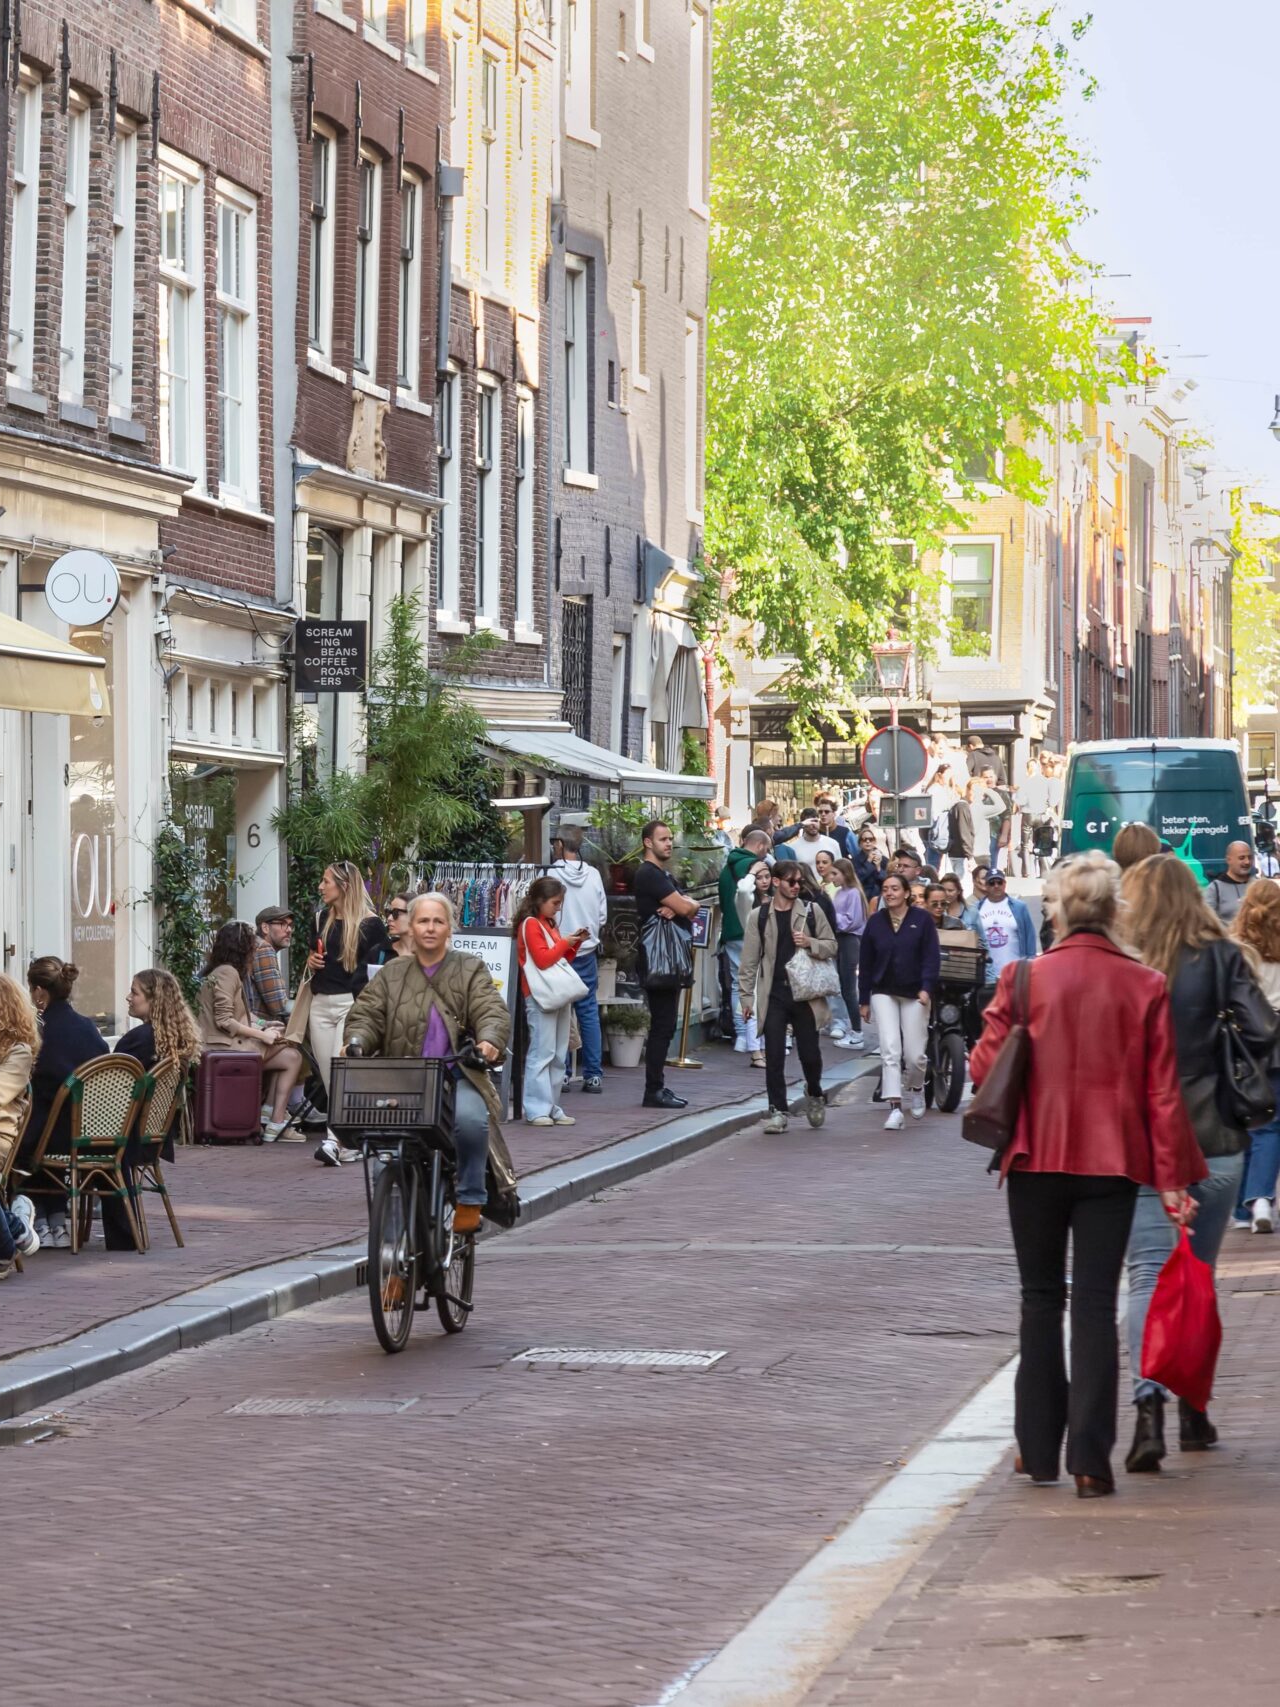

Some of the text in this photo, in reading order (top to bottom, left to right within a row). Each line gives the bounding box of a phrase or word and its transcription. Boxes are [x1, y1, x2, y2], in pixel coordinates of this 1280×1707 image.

[305, 628, 353, 637] SCREAM
[320, 648, 358, 656] BEANS
[304, 657, 348, 666] COFFEE
[320, 667, 358, 676] ROAST
[184, 804, 214, 829] SCREAM
[247, 823, 261, 848] 6
[453, 939, 498, 950] CREAM
